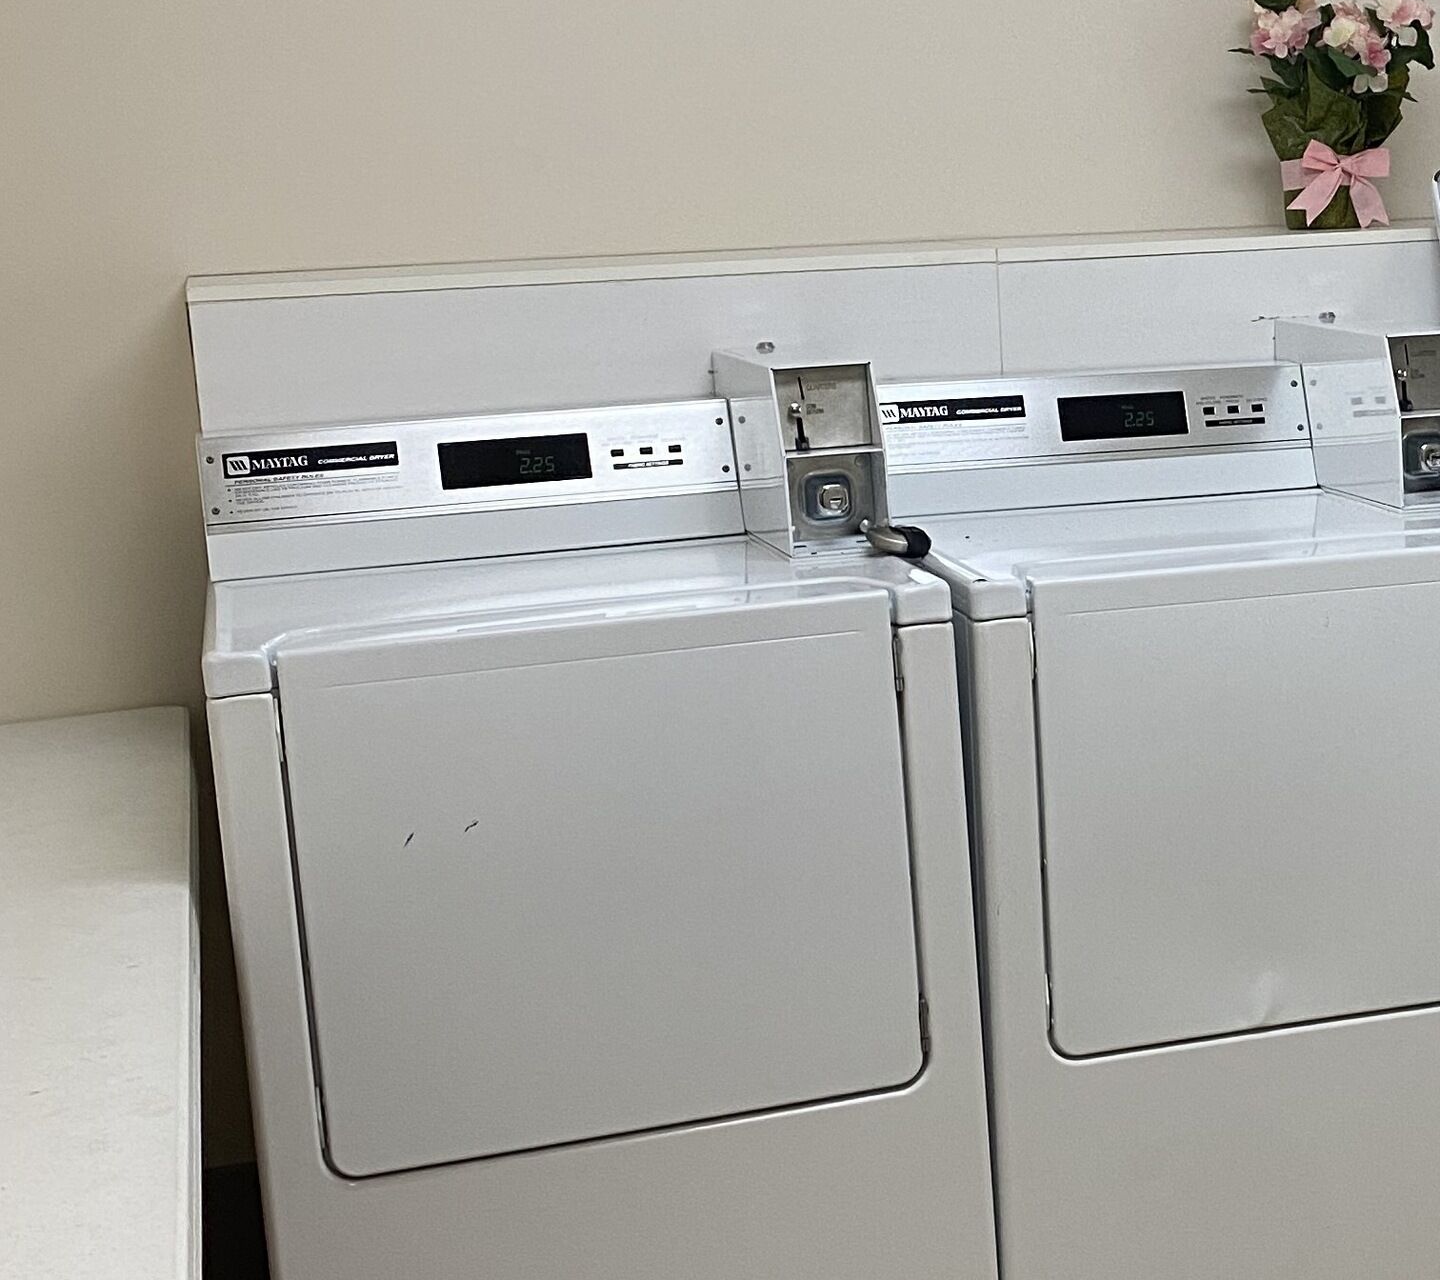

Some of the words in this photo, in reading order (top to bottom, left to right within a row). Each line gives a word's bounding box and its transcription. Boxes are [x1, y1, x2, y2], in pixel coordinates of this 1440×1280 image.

[900, 405, 948, 419] MAYTAG
[252, 455, 308, 471] MAYTAG
[519, 455, 555, 474] 2.25
